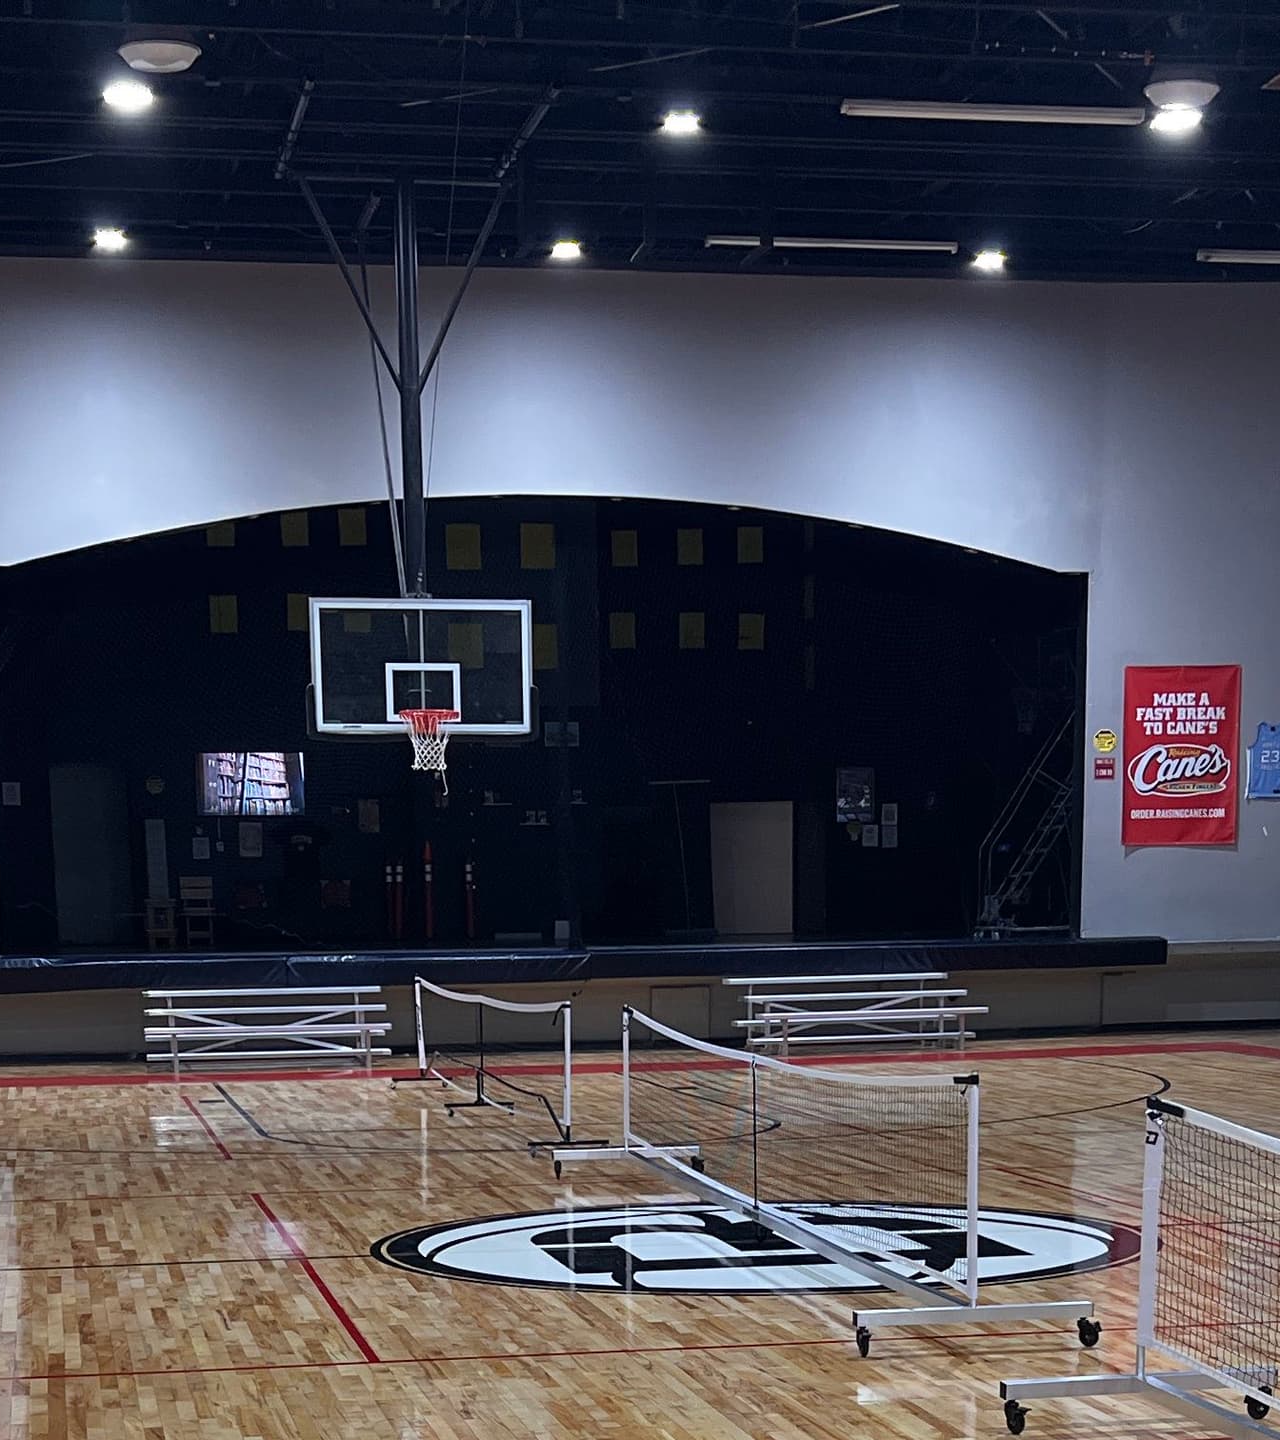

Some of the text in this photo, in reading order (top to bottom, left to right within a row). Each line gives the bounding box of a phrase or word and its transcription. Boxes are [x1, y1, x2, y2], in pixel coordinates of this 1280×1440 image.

[1153, 693, 1210, 706] MAKE A
[1136, 707, 1226, 721] FAST BREAK
[1144, 721, 1218, 735] TO CANE'S
[1261, 750, 1280, 763] 23
[1134, 744, 1227, 792] Cane's
